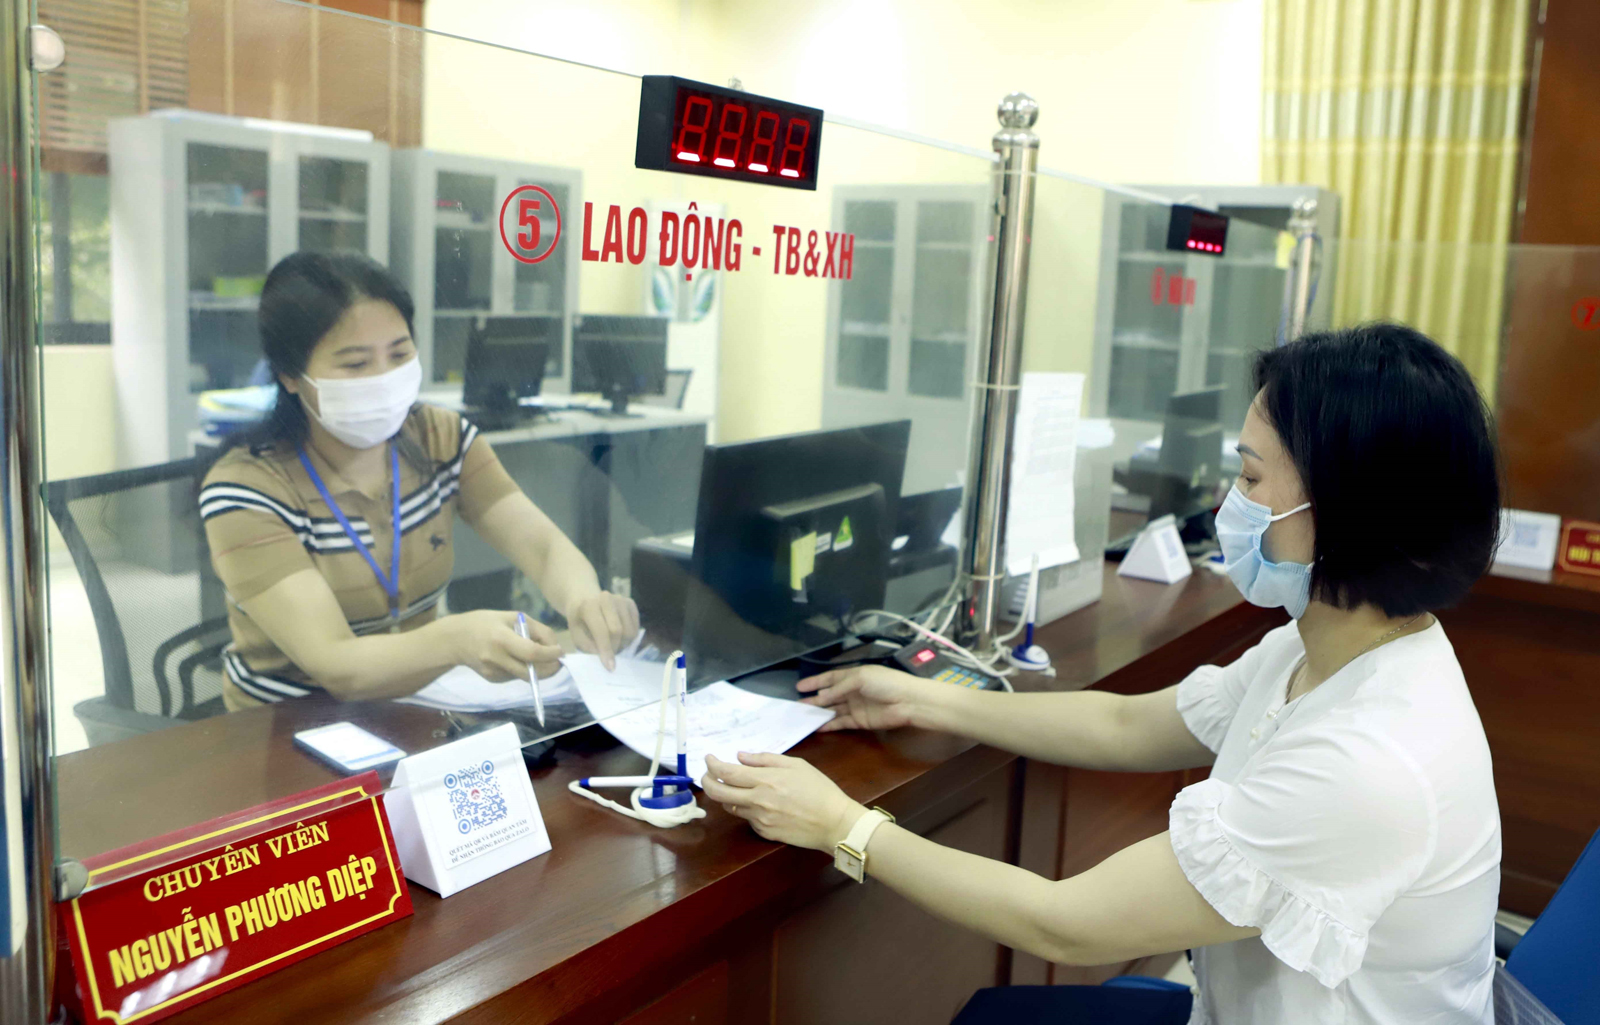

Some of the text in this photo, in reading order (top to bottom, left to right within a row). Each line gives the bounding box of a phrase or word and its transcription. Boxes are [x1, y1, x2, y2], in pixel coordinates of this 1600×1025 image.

[517, 199, 541, 250] 5
[582, 201, 648, 265] LAO
[659, 202, 742, 281] ĐỘNG
[773, 224, 855, 280] TB&XH
[143, 821, 330, 902] CHUYÊN VIÊN
[108, 854, 377, 988] NGUYỄN PHƯƠNG DIỆP
